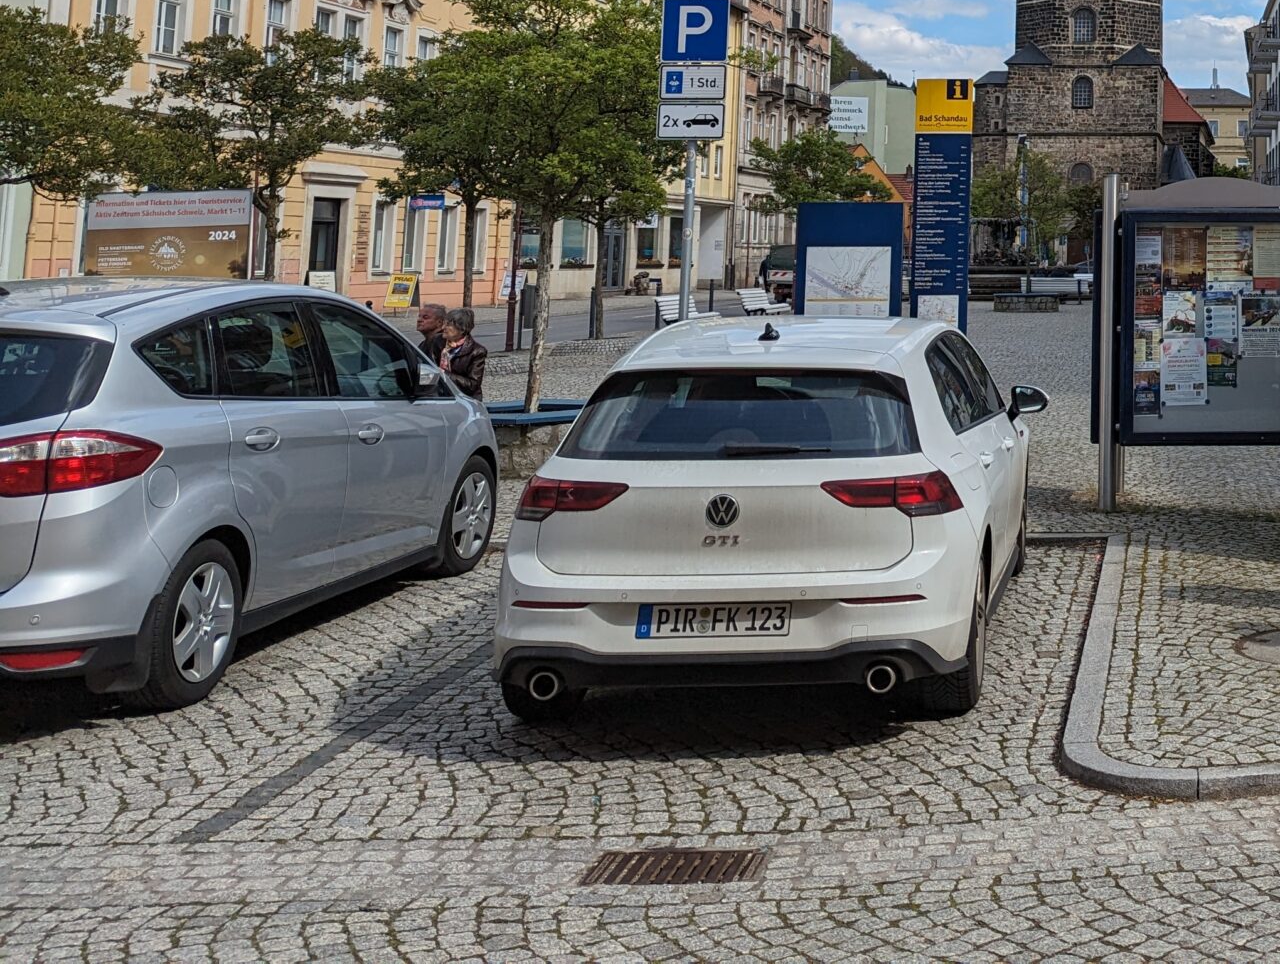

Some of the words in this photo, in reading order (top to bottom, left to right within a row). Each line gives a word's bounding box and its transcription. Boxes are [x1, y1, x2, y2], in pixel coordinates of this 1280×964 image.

[678, 5, 713, 54] P
[690, 78, 694, 88] 1
[697, 78, 719, 88] Std.
[662, 115, 679, 128] 2x
[934, 114, 968, 122] Schandau
[150, 198, 172, 206] Tickets
[142, 209, 176, 217] Sächsische
[208, 230, 236, 241] 2024
[704, 536, 740, 546] GTI
[656, 608, 697, 633] PIR
[711, 607, 740, 632] FK
[744, 606, 787, 631] 123
